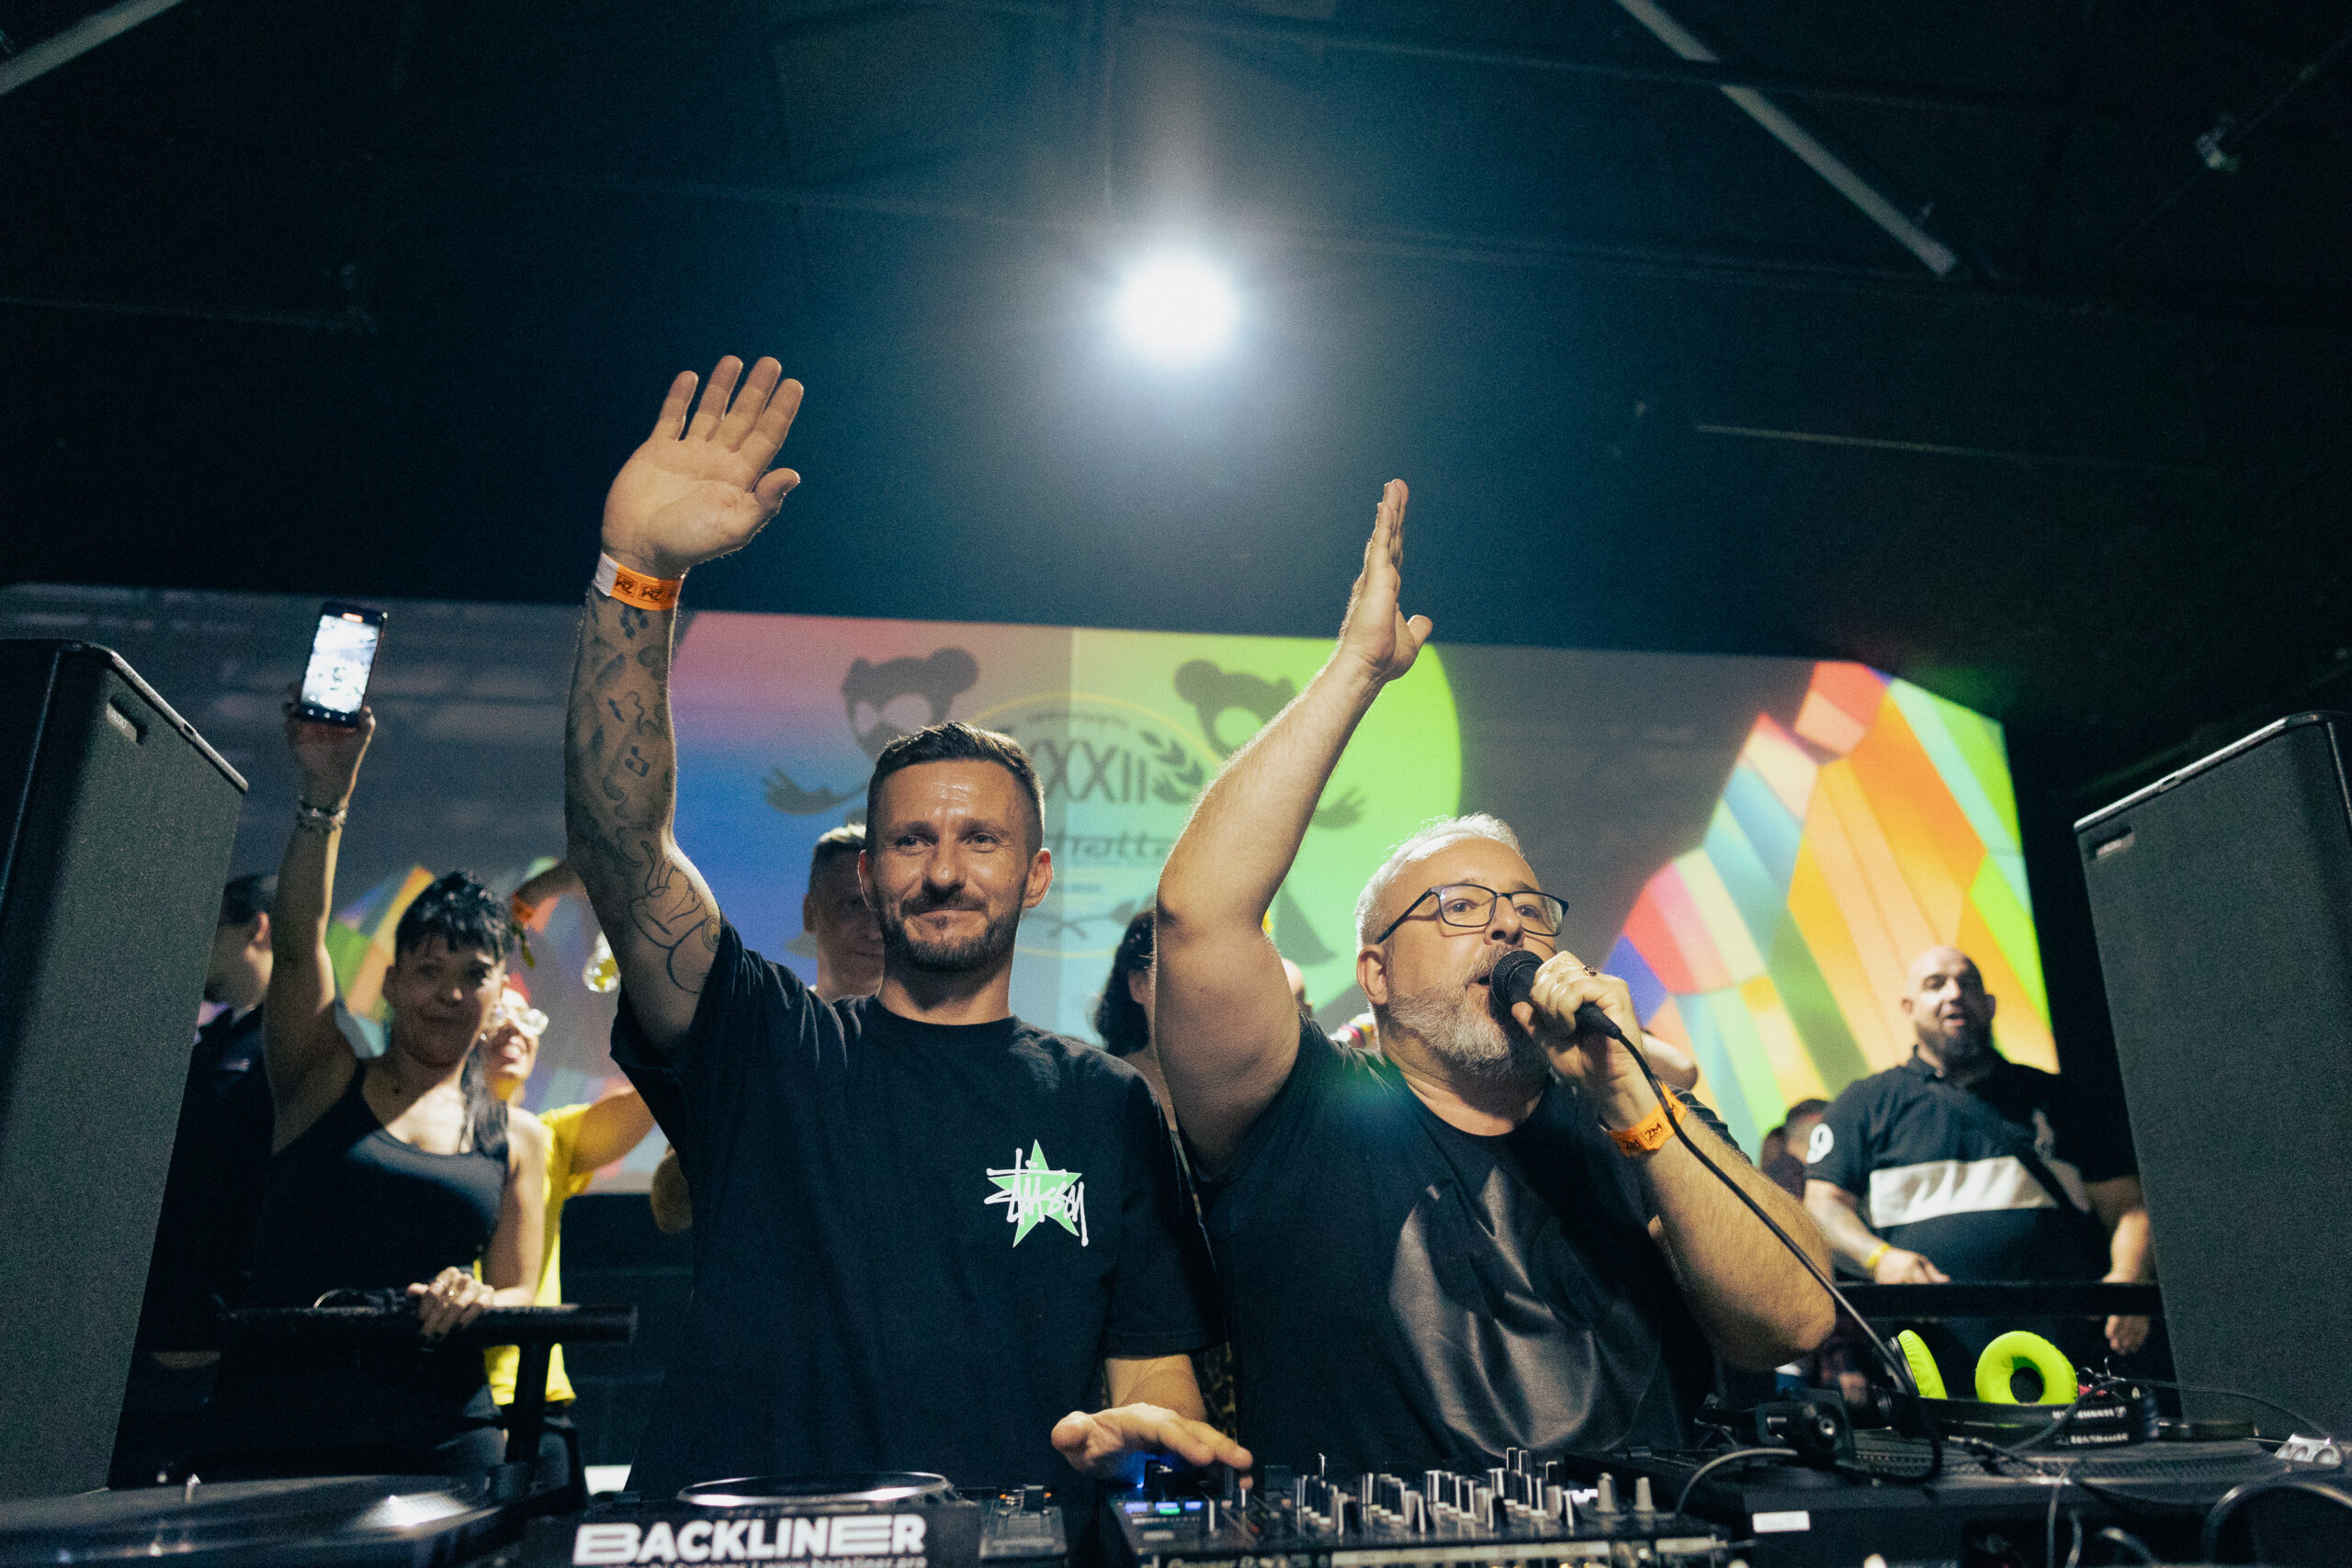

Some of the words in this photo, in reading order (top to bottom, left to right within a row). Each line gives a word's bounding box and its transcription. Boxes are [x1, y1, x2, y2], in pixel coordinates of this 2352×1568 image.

[1028, 738, 1148, 804] XXII
[1806, 1122, 1835, 1164] 9
[572, 1513, 927, 1565] BACKLINER
